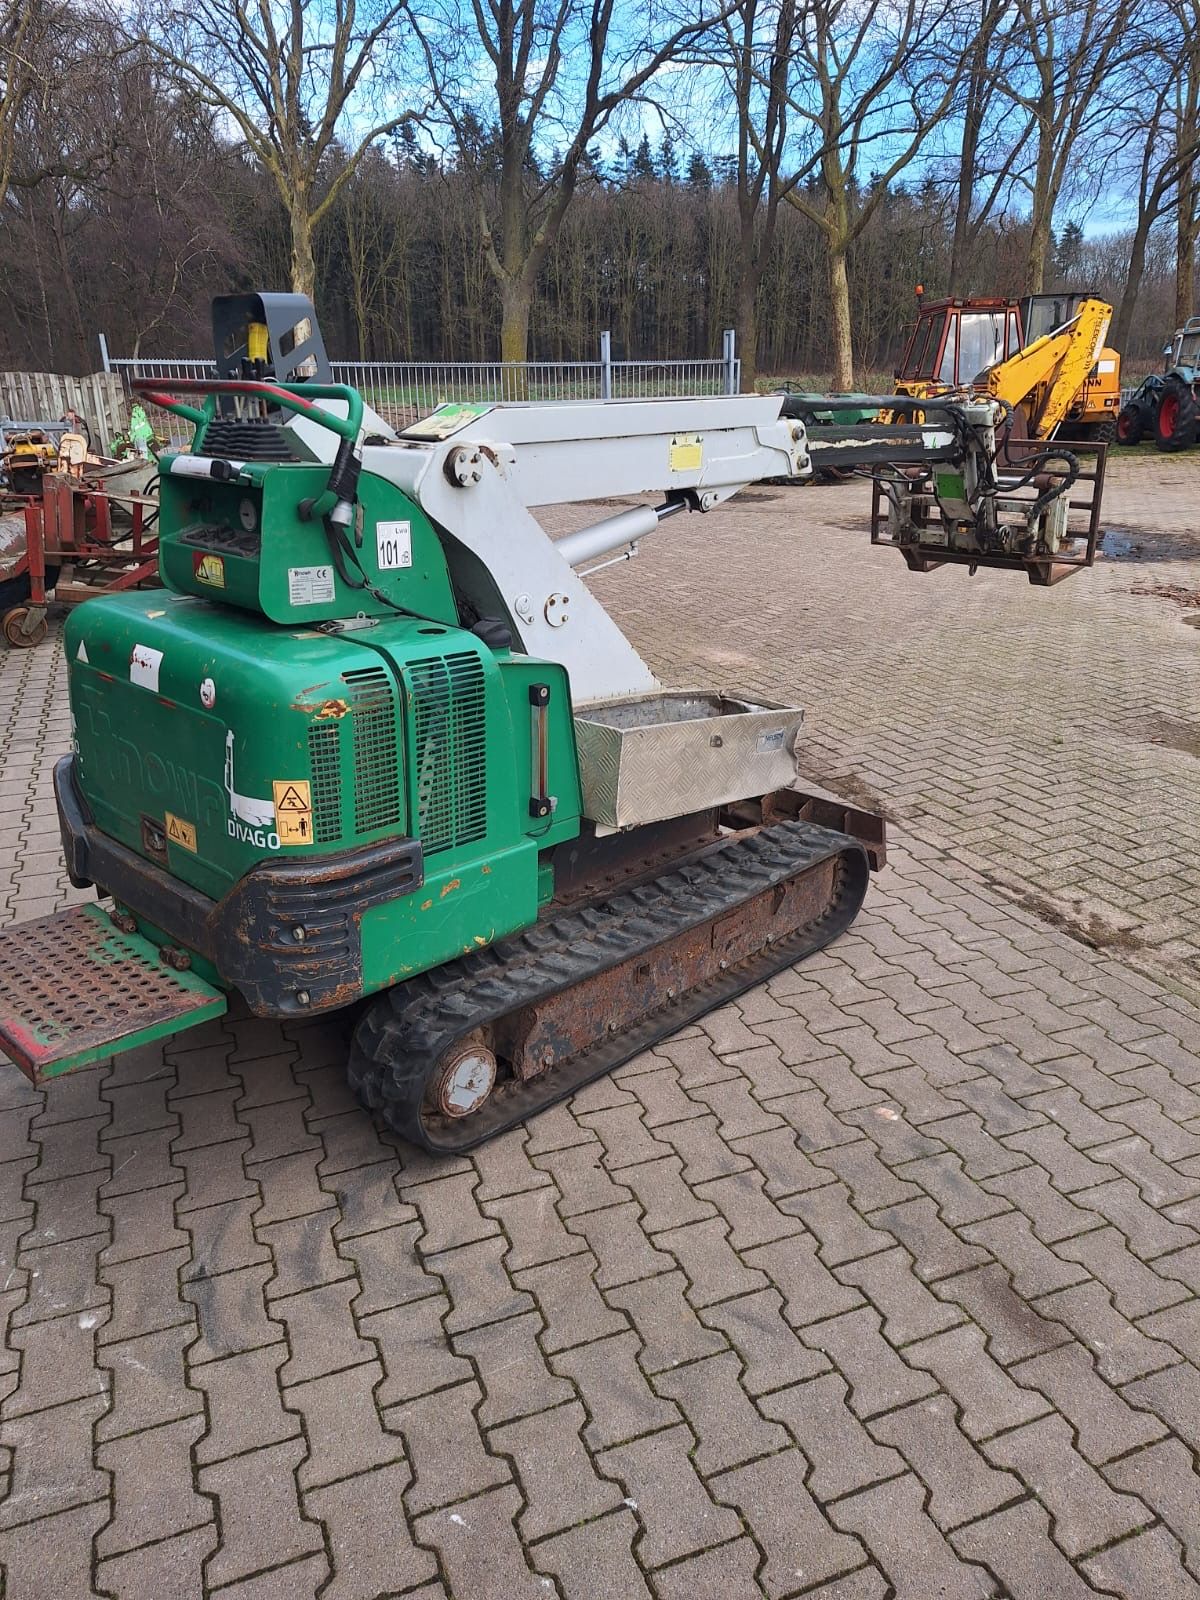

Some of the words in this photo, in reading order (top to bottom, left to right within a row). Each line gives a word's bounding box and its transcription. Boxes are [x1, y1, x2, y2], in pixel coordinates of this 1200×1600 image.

[380, 539, 399, 566] 101
[316, 569, 327, 579] CE
[227, 818, 281, 850] DIVAGO
